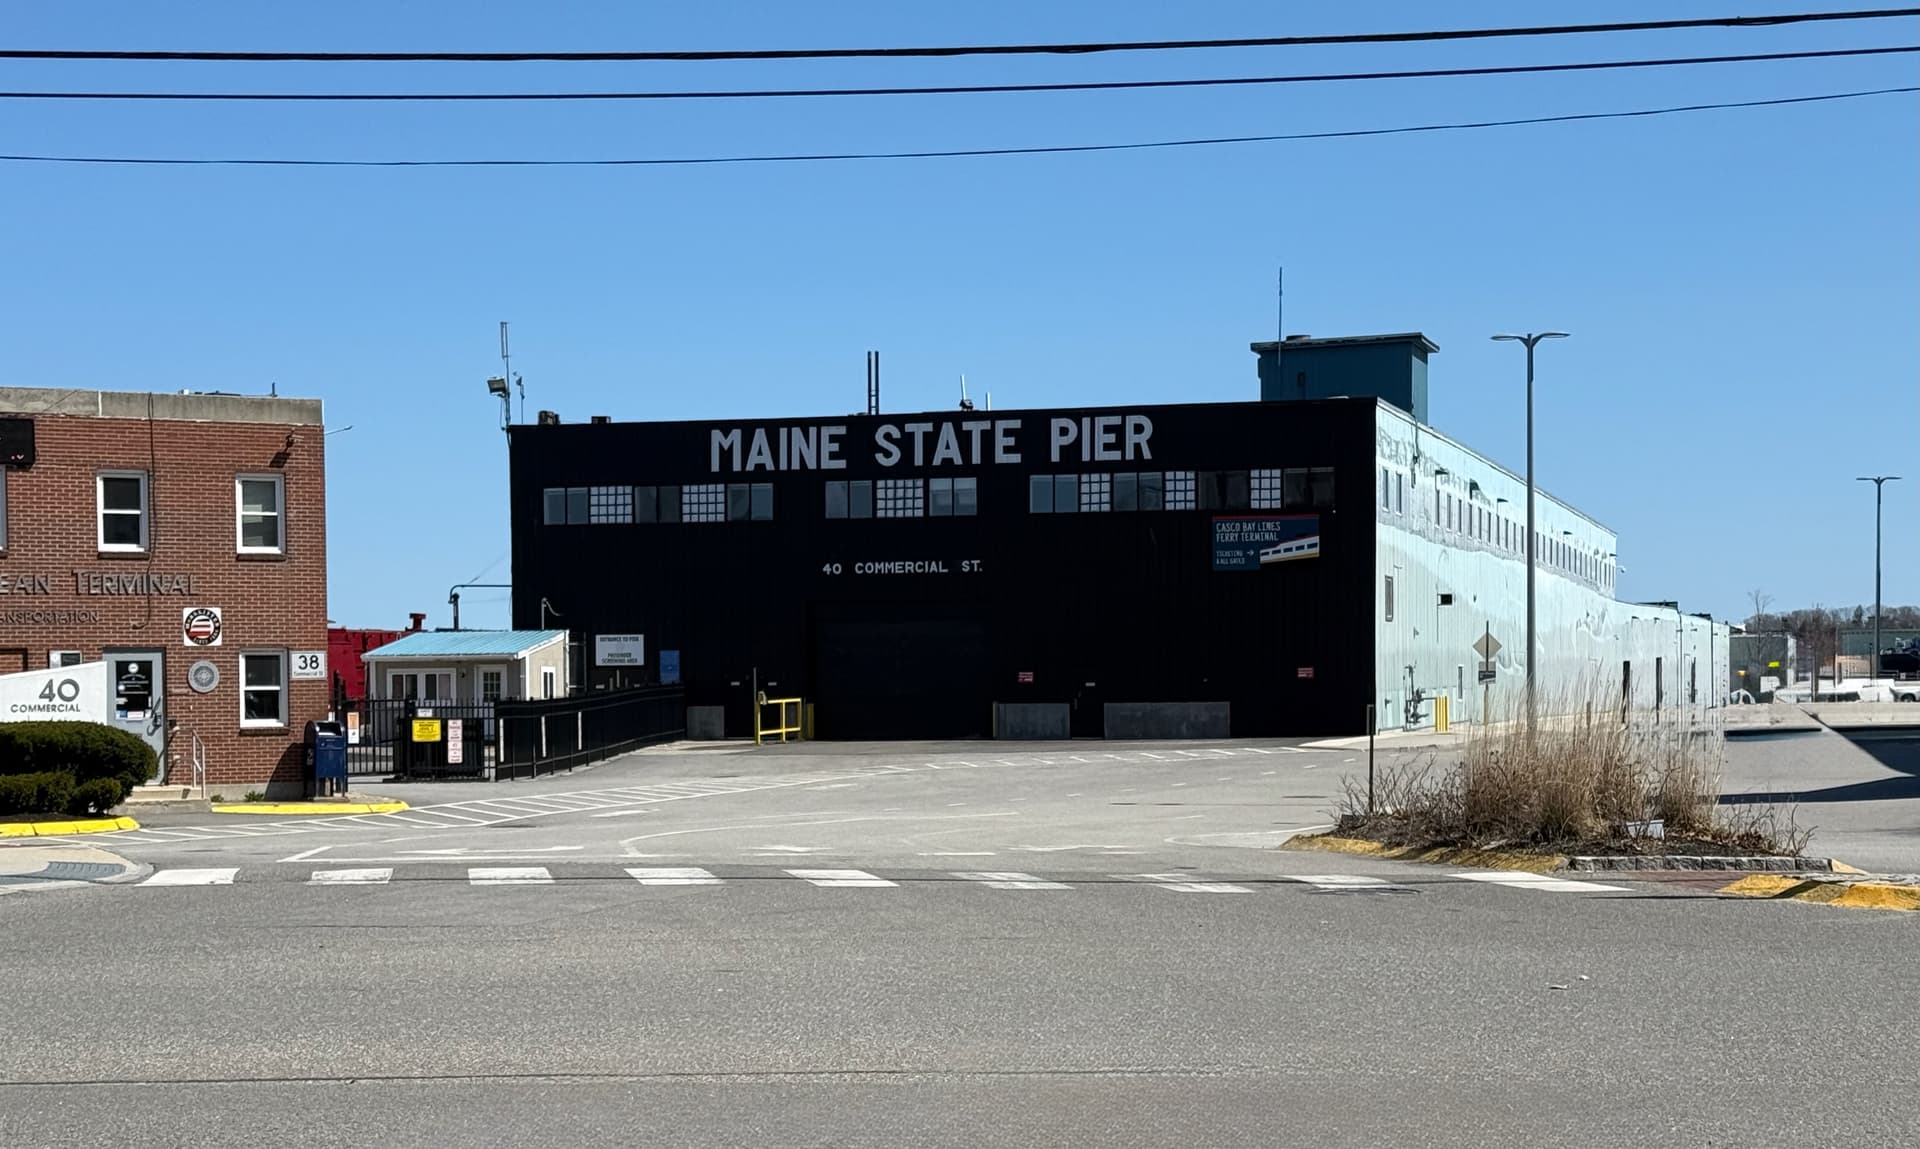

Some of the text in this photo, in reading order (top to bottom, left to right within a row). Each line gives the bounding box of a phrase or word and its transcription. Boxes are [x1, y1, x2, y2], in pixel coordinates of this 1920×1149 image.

[710, 414, 1153, 472] MAINE STATE PIER
[1216, 521, 1281, 533] CASCO BAY LINES
[1216, 532, 1279, 543] FERRY TERMINAL
[822, 559, 983, 575] 40 COMMERCIAL ST.
[0, 570, 200, 596] EAN TERMINAL
[298, 654, 320, 670] 38
[38, 678, 80, 702] 40
[10, 703, 81, 713] COMMERCIAL
